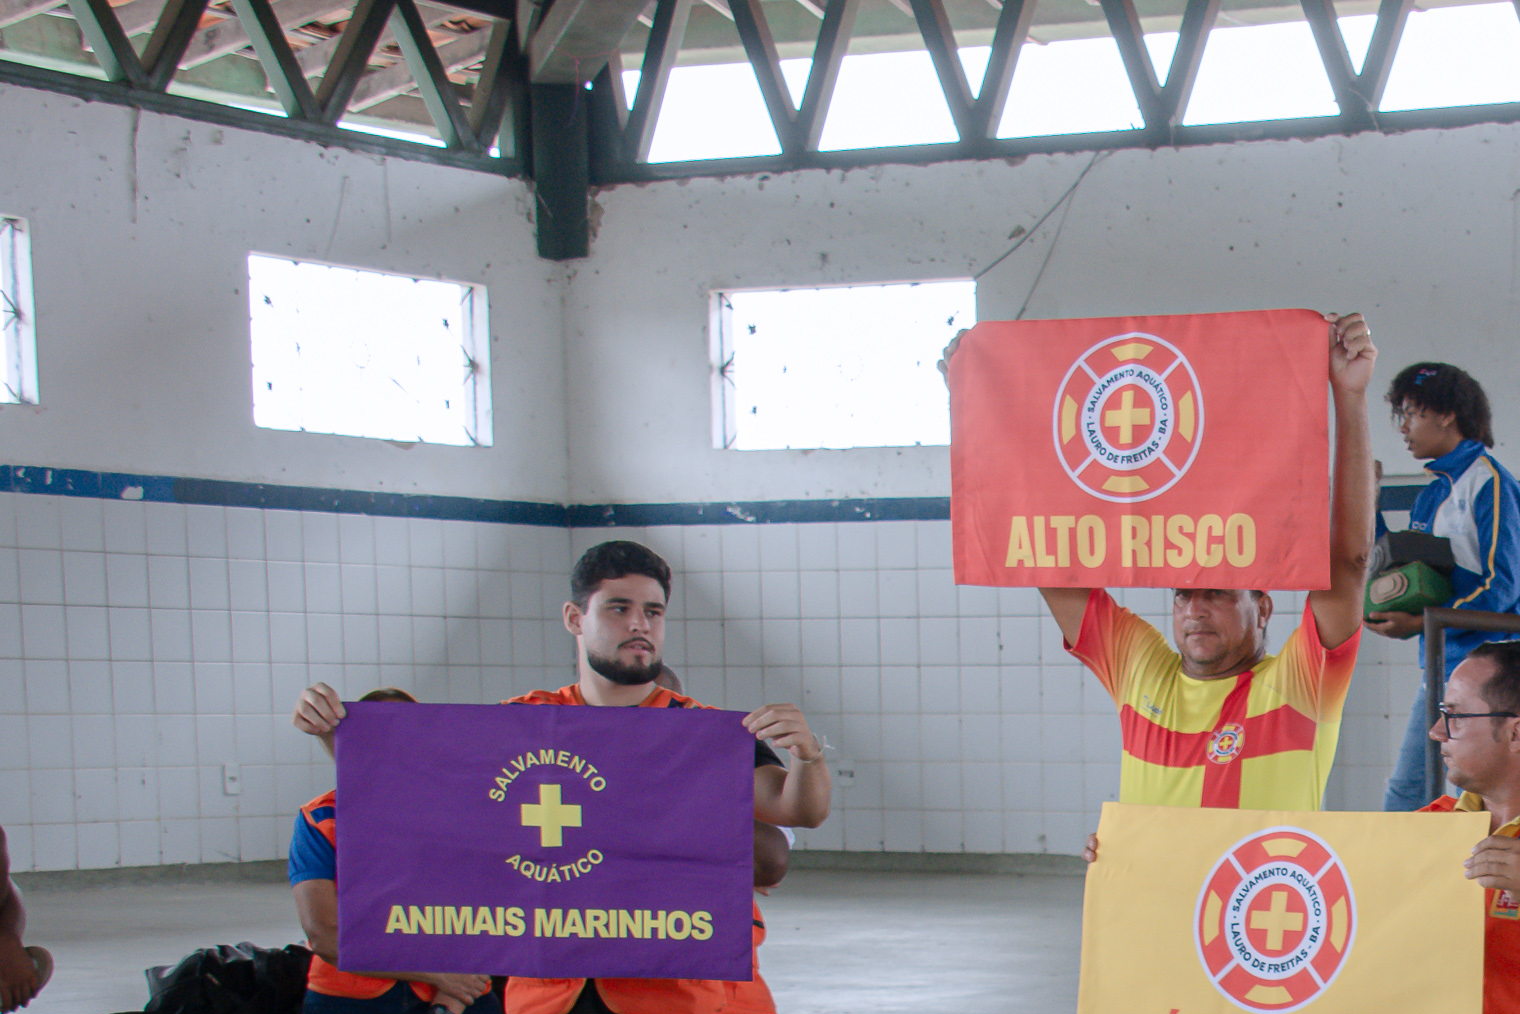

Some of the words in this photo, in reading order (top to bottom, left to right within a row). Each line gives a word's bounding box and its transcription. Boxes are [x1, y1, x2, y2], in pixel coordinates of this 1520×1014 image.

[1087, 368, 1135, 413] SALVAMENTO
[1136, 370, 1168, 411] AQUÁTICO
[1086, 421, 1107, 456] LAURO
[1106, 452, 1120, 464] DE
[1120, 440, 1159, 464] FREITAS
[1158, 418, 1169, 435] BA
[1004, 514, 1107, 569] ALTO
[1120, 513, 1256, 569] RISCO
[488, 749, 607, 803] SALVAMENTO
[505, 848, 604, 883] AQUÁTICO
[1232, 867, 1288, 912] SALVAMENTO
[1289, 870, 1321, 917] AQUÁTICO
[385, 904, 527, 937] ANIMAIS
[534, 907, 715, 941] MARINHOS
[1230, 922, 1252, 962] LAURO
[1251, 958, 1266, 972] DE
[1267, 949, 1308, 973] FREITAS
[1309, 925, 1321, 943] BA
